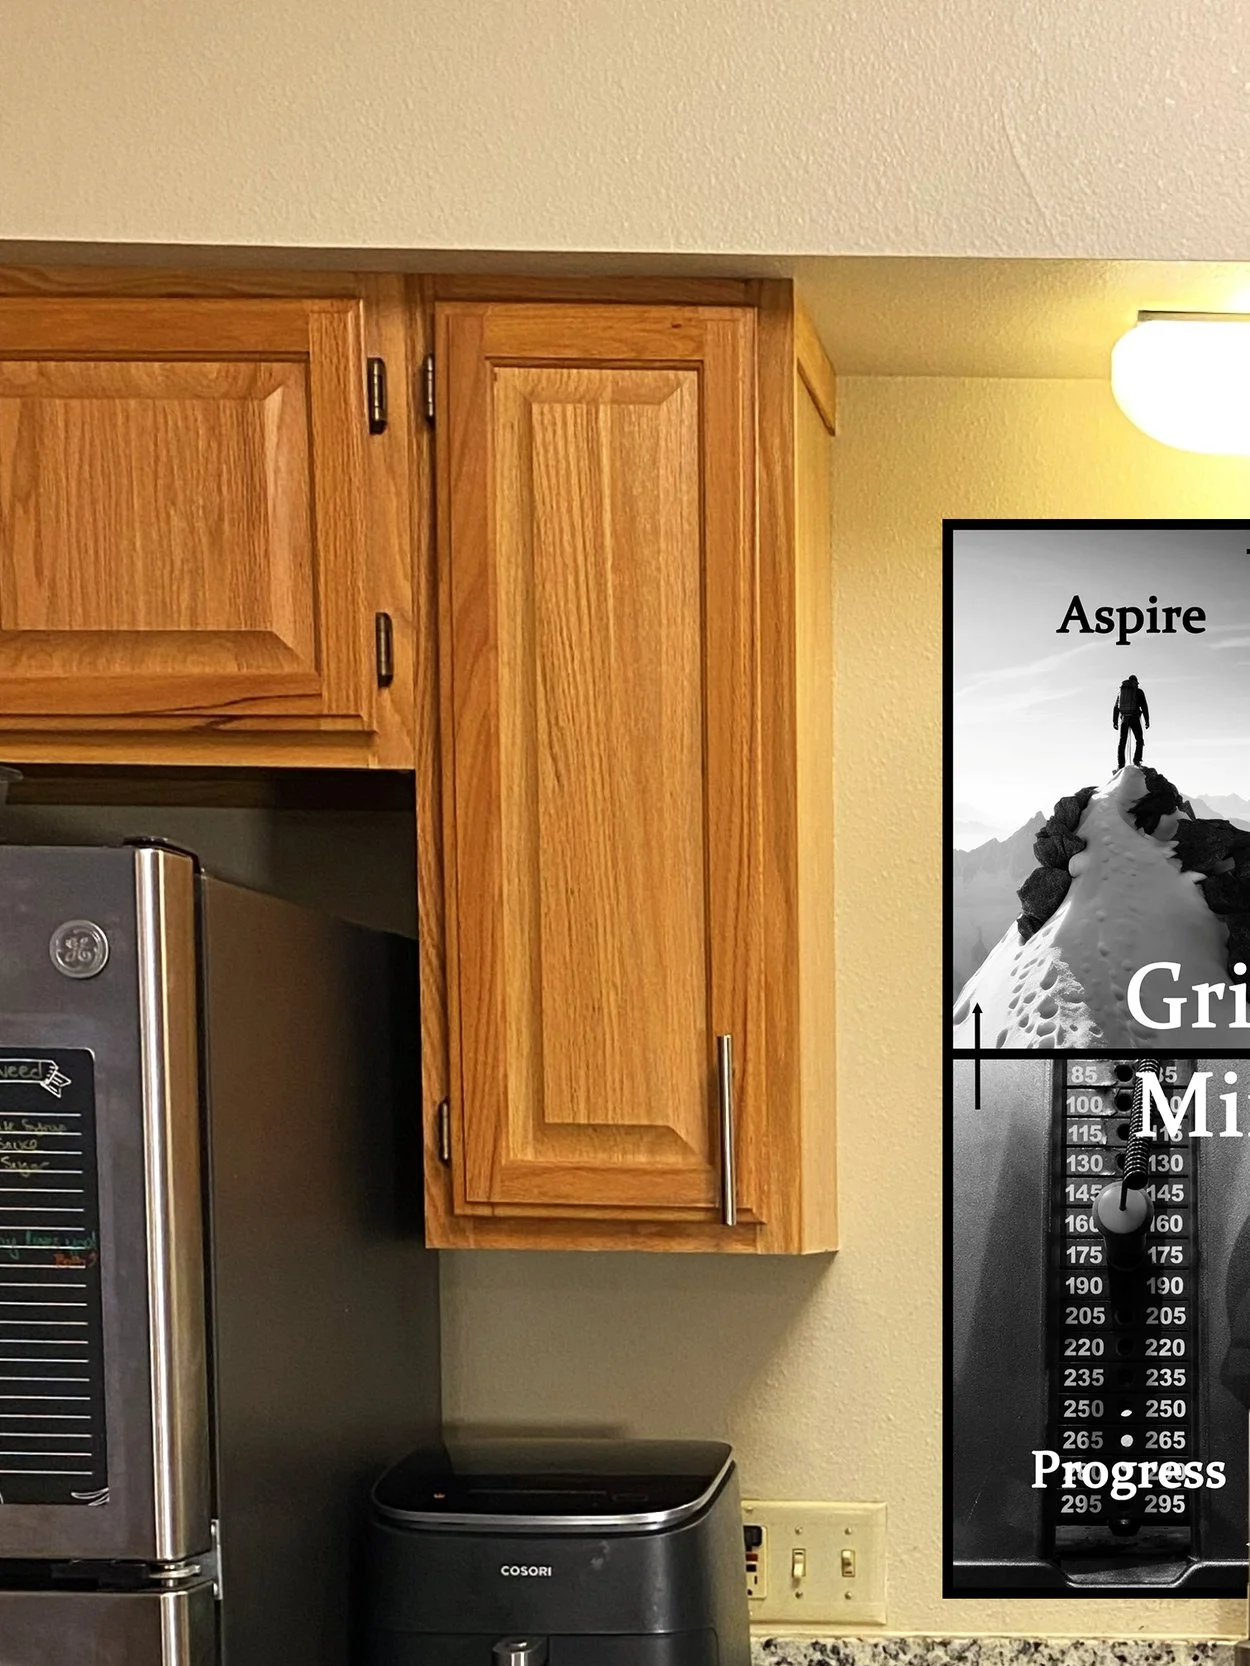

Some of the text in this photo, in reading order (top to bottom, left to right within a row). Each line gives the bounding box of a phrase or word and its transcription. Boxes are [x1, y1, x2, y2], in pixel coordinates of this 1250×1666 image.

[1056, 595, 1206, 646] Aspire
[1071, 1066, 1098, 1083] 85
[1066, 1096, 1103, 1113] 100
[1068, 1125, 1102, 1142] 115
[1066, 1154, 1184, 1172] 130 130
[1147, 1184, 1184, 1202] 145
[1150, 1215, 1183, 1232] 160
[1066, 1246, 1184, 1264] 175 175
[1065, 1277, 1184, 1295] 190 190
[1065, 1307, 1187, 1325] 205 205
[1064, 1338, 1186, 1356] 220 220
[1063, 1369, 1186, 1387] 235 235
[1063, 1400, 1186, 1418] 250 250
[1062, 1431, 1186, 1449] 265 265
[1031, 1450, 1227, 1500] Progress
[1061, 1495, 1186, 1513] 295 295
[500, 1565, 552, 1577] COSORI
